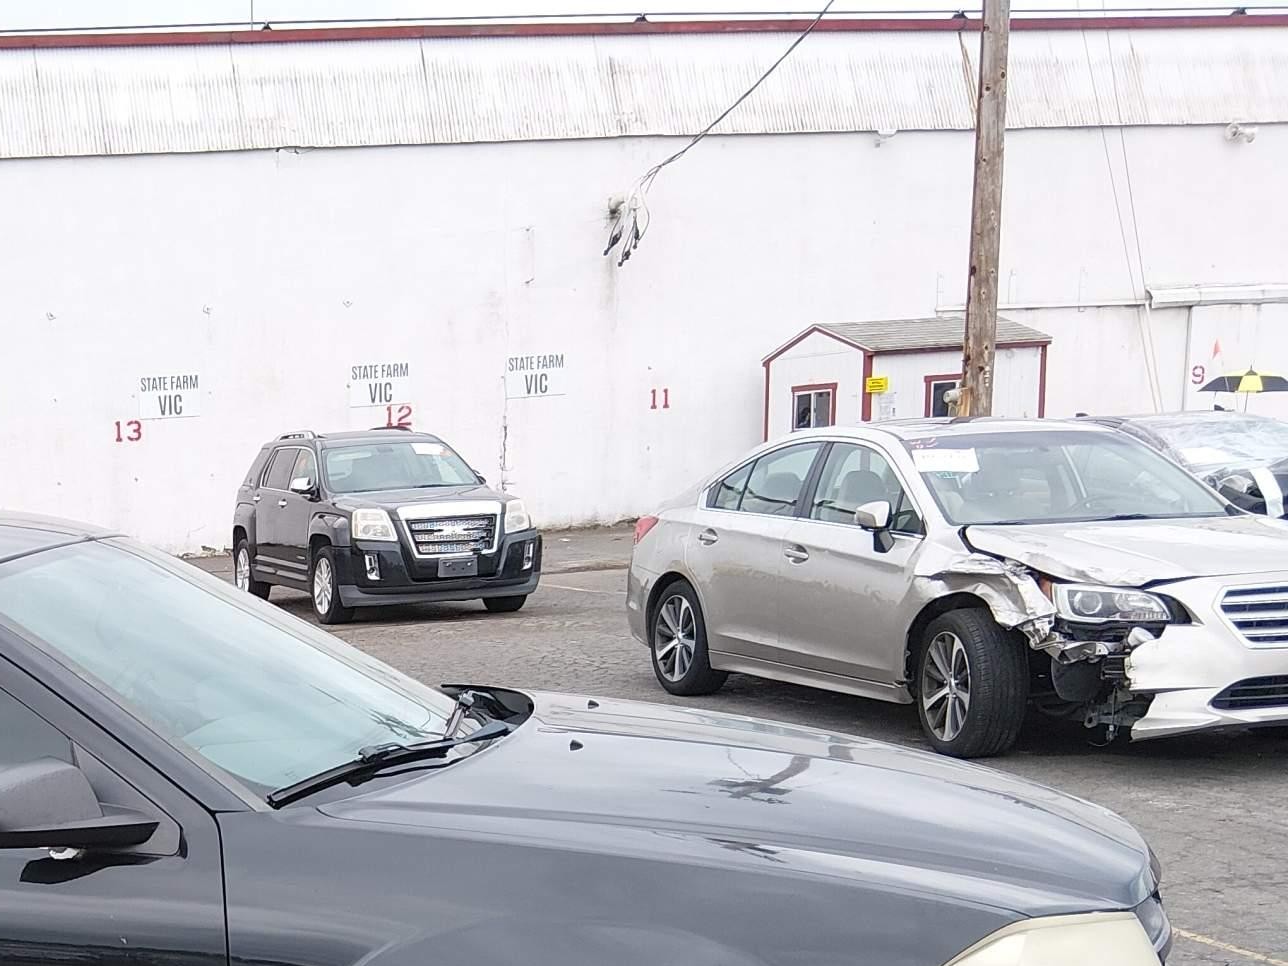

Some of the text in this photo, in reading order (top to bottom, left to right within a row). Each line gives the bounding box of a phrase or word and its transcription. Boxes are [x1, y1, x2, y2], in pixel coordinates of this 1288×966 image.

[351, 363, 409, 381] STATE FARM
[508, 354, 564, 372] STATE FARM
[140, 375, 199, 392] STATE FARM
[524, 374, 548, 395] VIC
[1192, 365, 1205, 385] 9
[369, 382, 393, 403] VIC
[650, 388, 670, 409] 11
[158, 394, 183, 416] VIC
[386, 405, 412, 428] 12
[115, 420, 142, 442] 13
